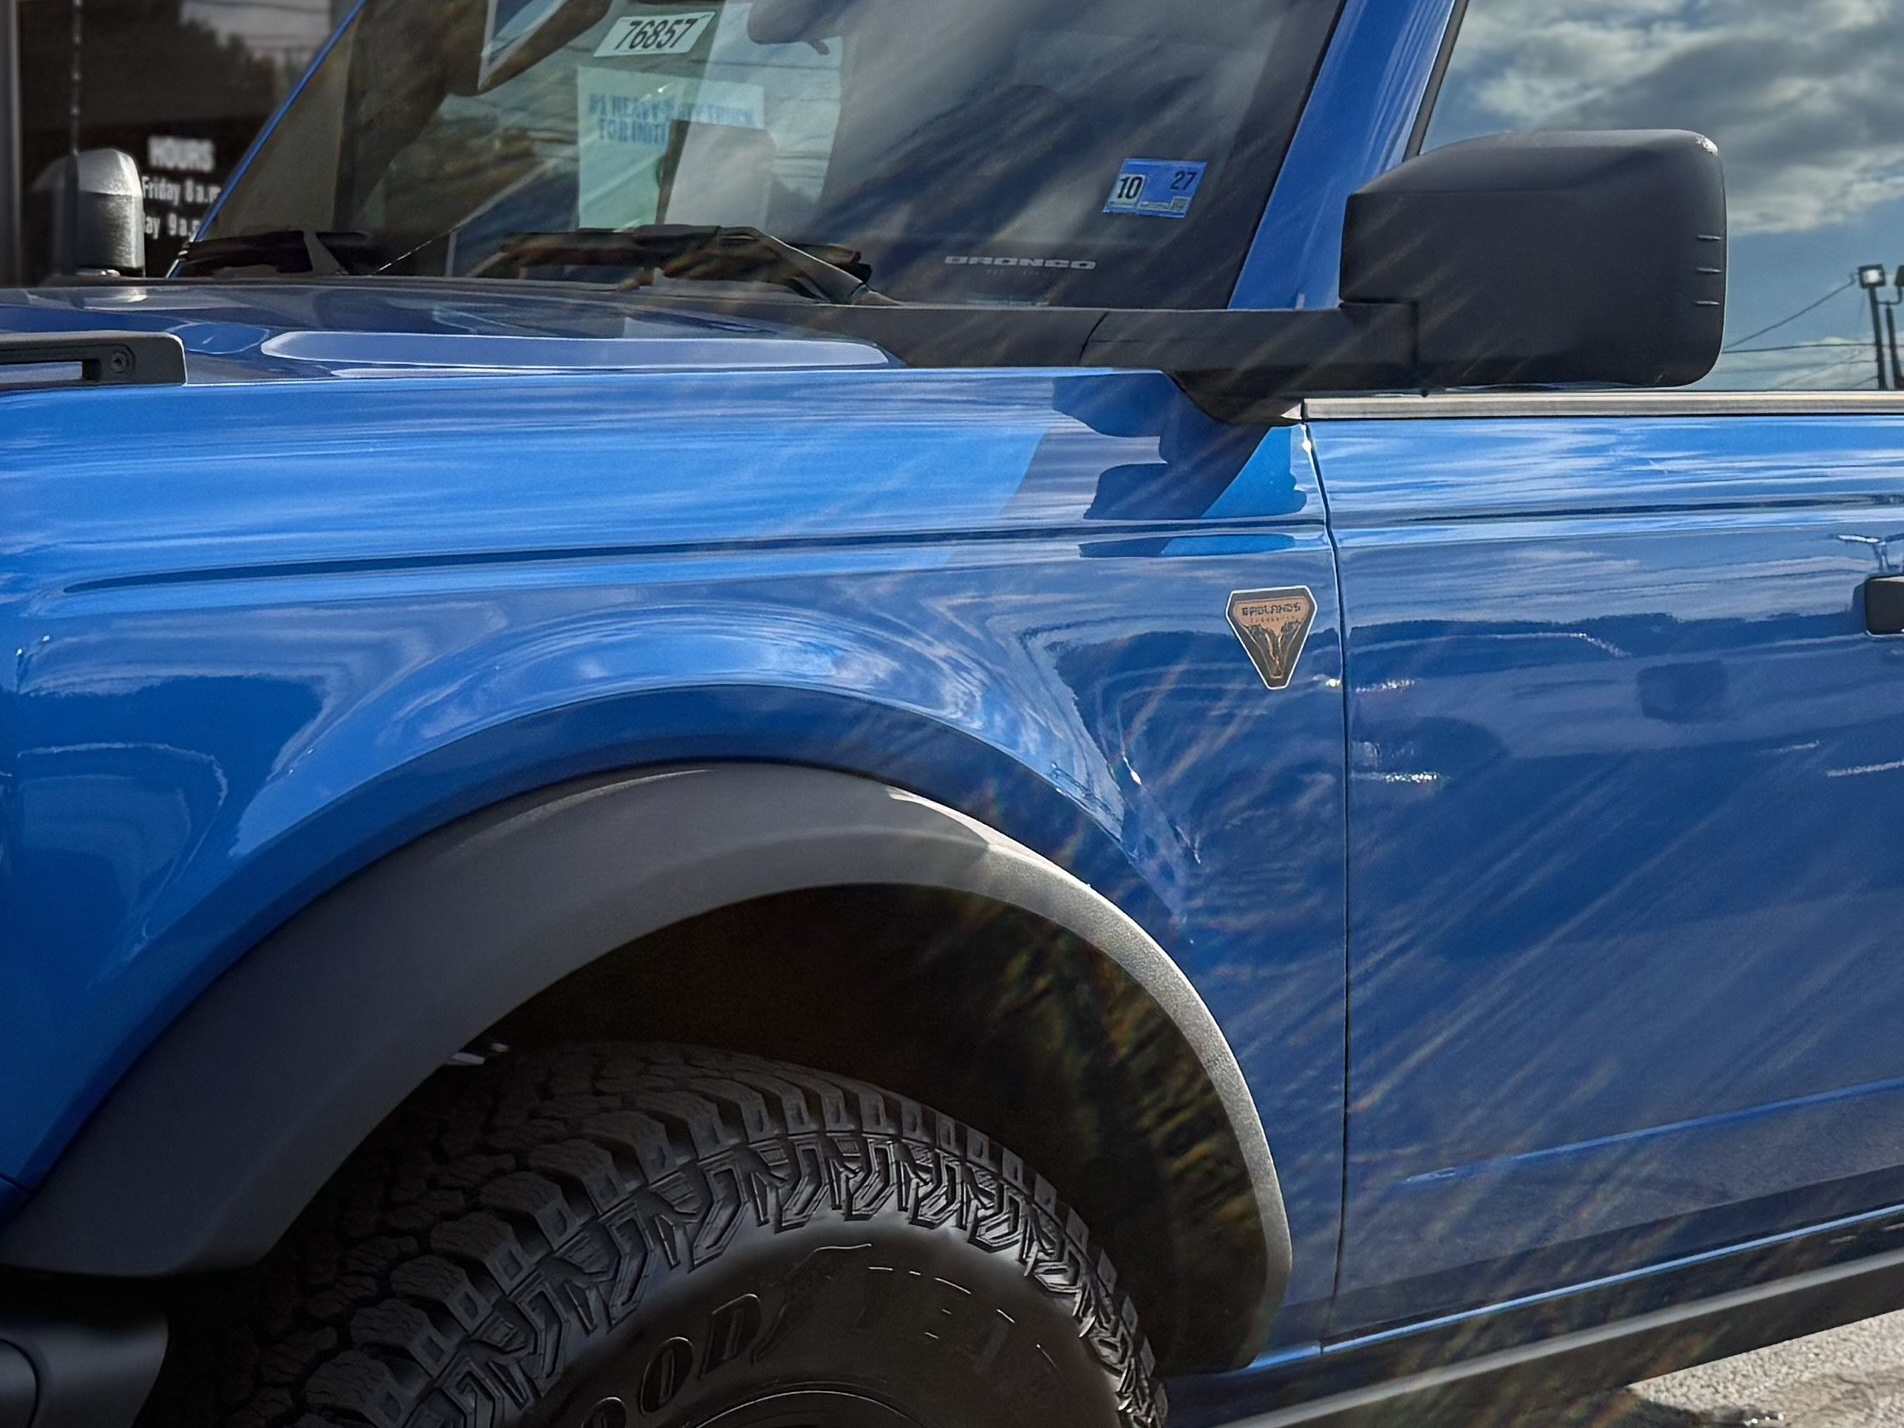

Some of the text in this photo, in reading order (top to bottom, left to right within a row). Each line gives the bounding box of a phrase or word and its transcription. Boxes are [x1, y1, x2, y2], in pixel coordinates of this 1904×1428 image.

[614, 17, 699, 51] 76857
[1116, 169, 1197, 200] 10 27
